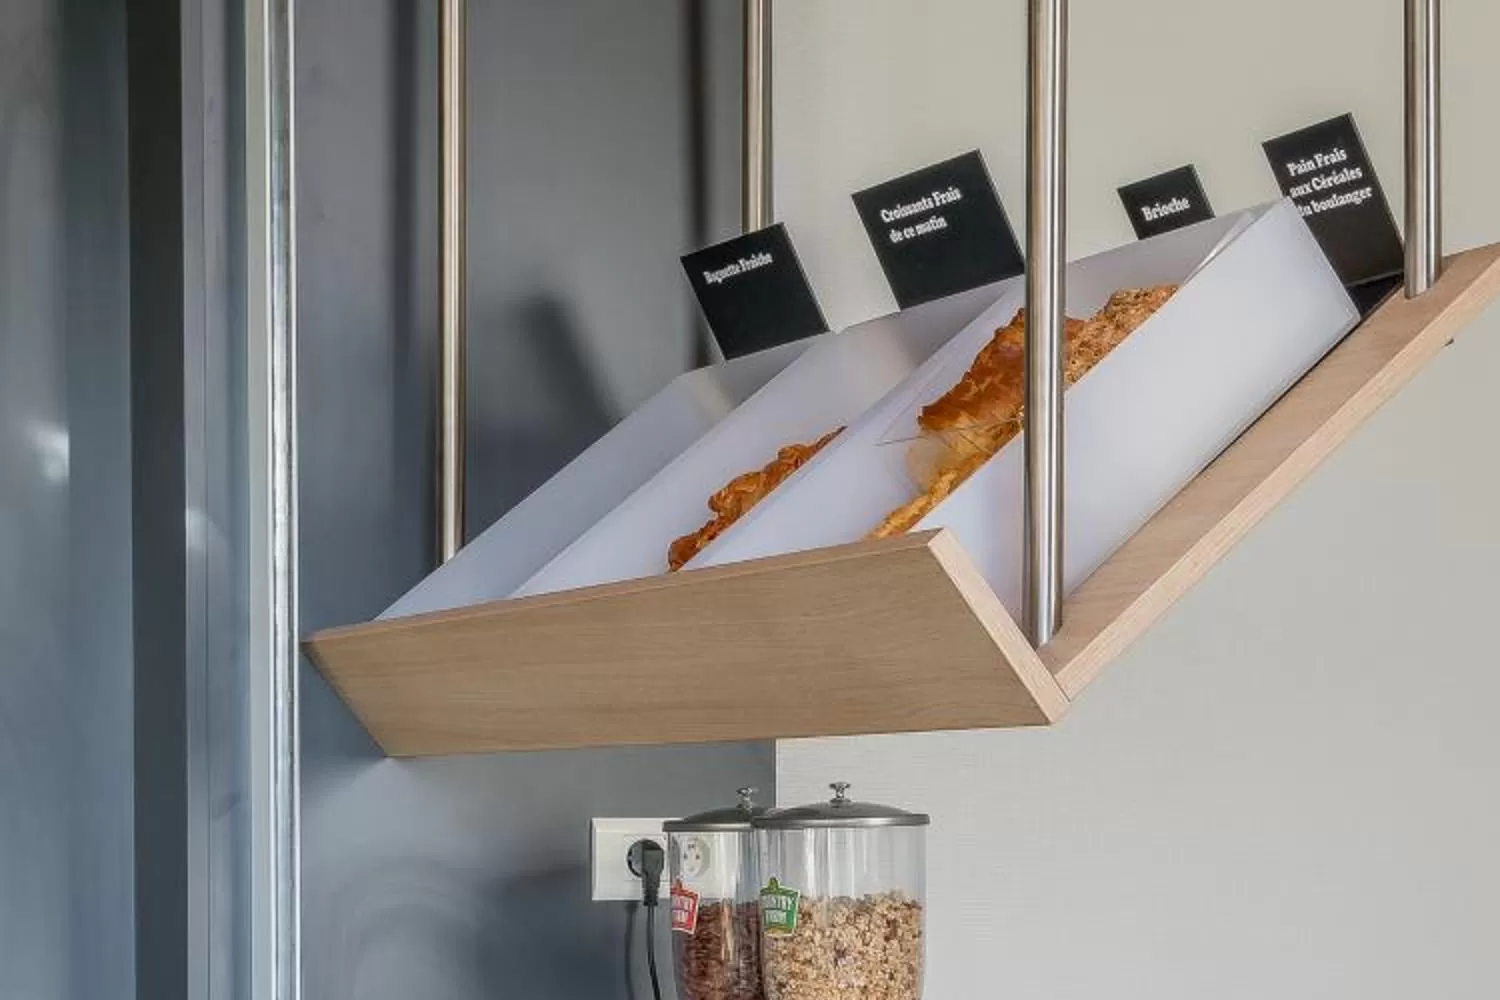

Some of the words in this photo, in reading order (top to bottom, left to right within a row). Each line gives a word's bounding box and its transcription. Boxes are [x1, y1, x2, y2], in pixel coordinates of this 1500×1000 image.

[1287, 160, 1317, 177] Pain
[1316, 148, 1348, 167] Frais
[1311, 167, 1363, 192] Céréales
[932, 186, 962, 206] Frais
[1141, 196, 1191, 222] Brioche
[1310, 186, 1373, 213] boulanger
[889, 230, 904, 243] de
[903, 226, 916, 239] ce
[915, 216, 948, 235] matin
